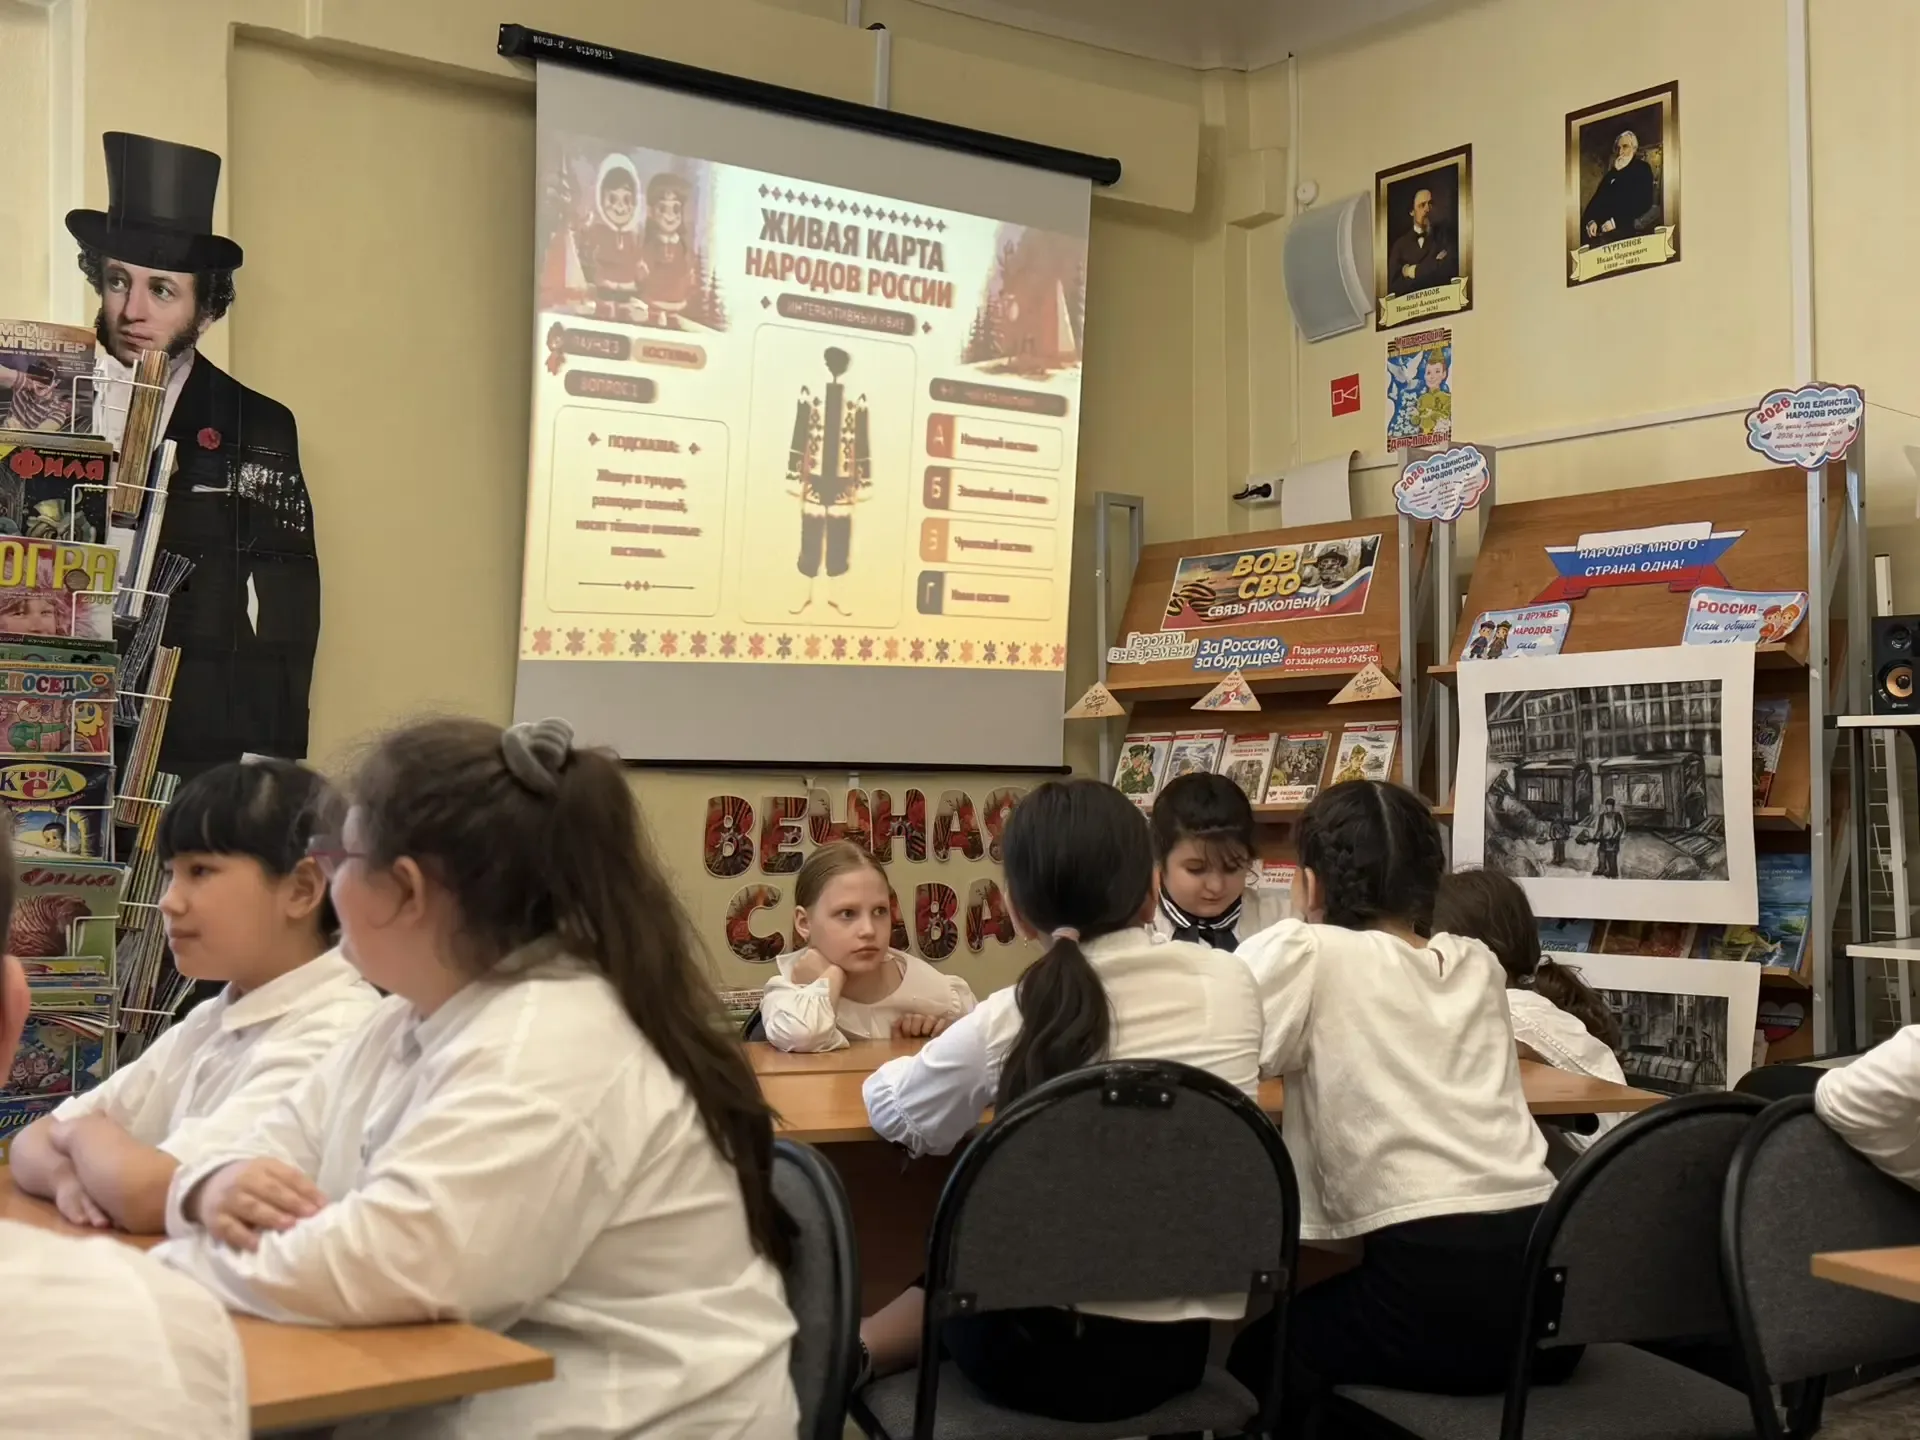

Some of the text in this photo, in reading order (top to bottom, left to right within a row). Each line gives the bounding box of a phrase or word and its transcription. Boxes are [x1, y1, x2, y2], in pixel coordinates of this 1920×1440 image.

[759, 208, 945, 272] ЖИВАЯ КАРТА
[745, 246, 954, 309] НАРОДОВ РОССИИ
[1757, 397, 1852, 424] 2026 ГОД ЕДИНСТВА
[1786, 406, 1857, 420] НАРОДОВ РОССИИ
[933, 424, 945, 447] А
[9, 446, 106, 481] Филя
[1400, 452, 1473, 491] 2026 ГОД ЕДИНСТВА
[1422, 460, 1479, 484] НАРОДОВ РОССИИ
[931, 476, 942, 499] Б
[1579, 543, 1644, 560] НАРОДОВ
[1646, 538, 1699, 554] МНОГО
[1231, 550, 1298, 578] ВОВ
[1584, 558, 1685, 578] СТРАНА ОДНА!
[925, 581, 936, 605] Г
[1238, 572, 1302, 600] СВО
[1517, 609, 1560, 621] В ДРУЖБЕ
[1692, 619, 1757, 632] наш общий
[1130, 633, 1184, 648] Героизм
[1512, 625, 1553, 636] НАРОДОВ
[1111, 642, 1197, 664] вне времени!
[1200, 638, 1281, 655] За Россию,
[1324, 646, 1336, 655] не
[1194, 648, 1286, 669] за будущее!
